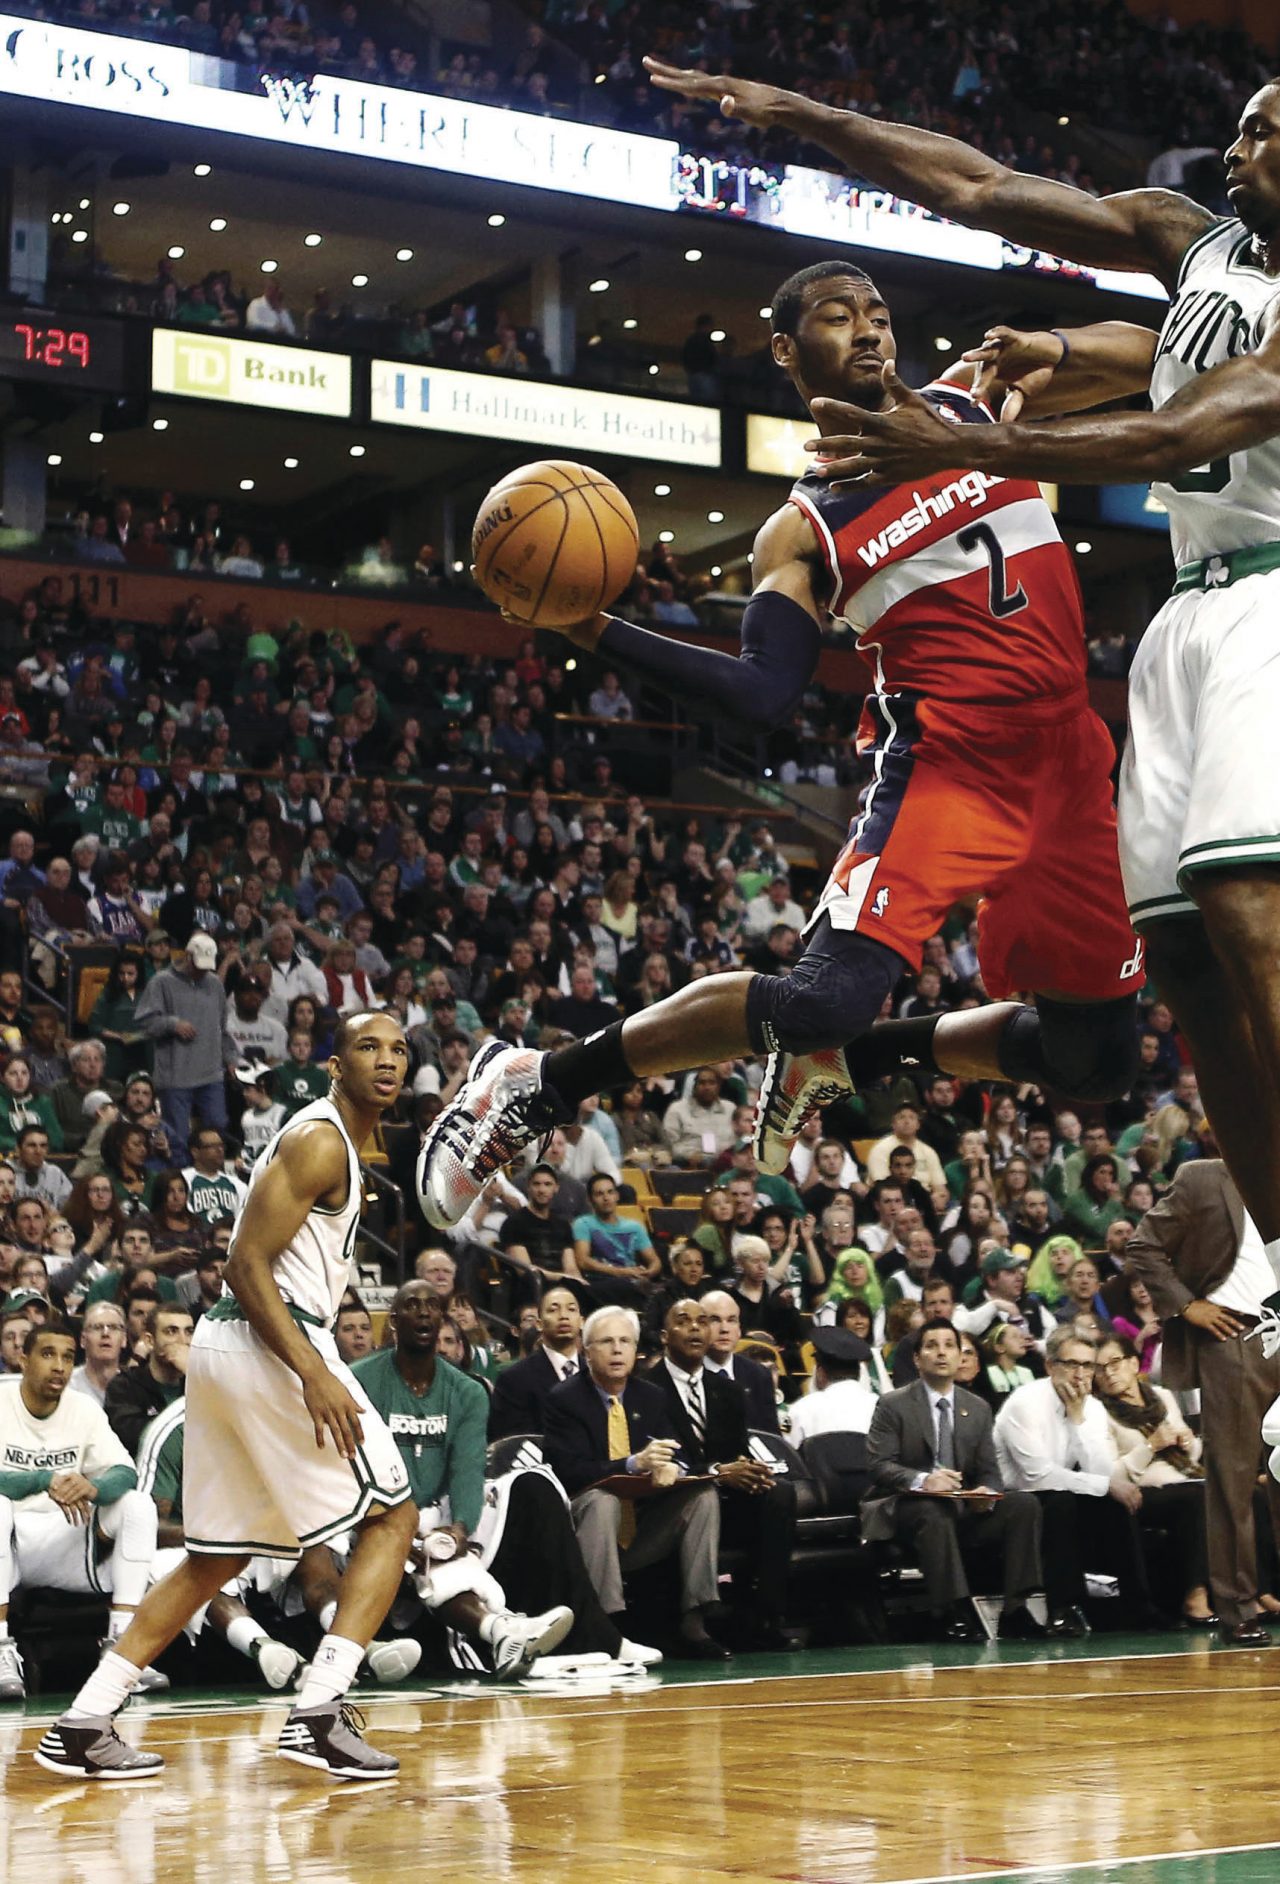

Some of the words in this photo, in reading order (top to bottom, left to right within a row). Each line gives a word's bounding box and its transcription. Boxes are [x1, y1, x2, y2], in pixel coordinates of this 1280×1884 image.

[15, 324, 90, 369] 7:29
[178, 345, 227, 387] TD
[243, 356, 328, 391] Bank
[452, 389, 589, 431] Hallmark
[603, 411, 696, 446] Health
[956, 521, 1029, 620] 2
[388, 1414, 448, 1435] BOSTON
[33, 1450, 78, 1469] GREEN
